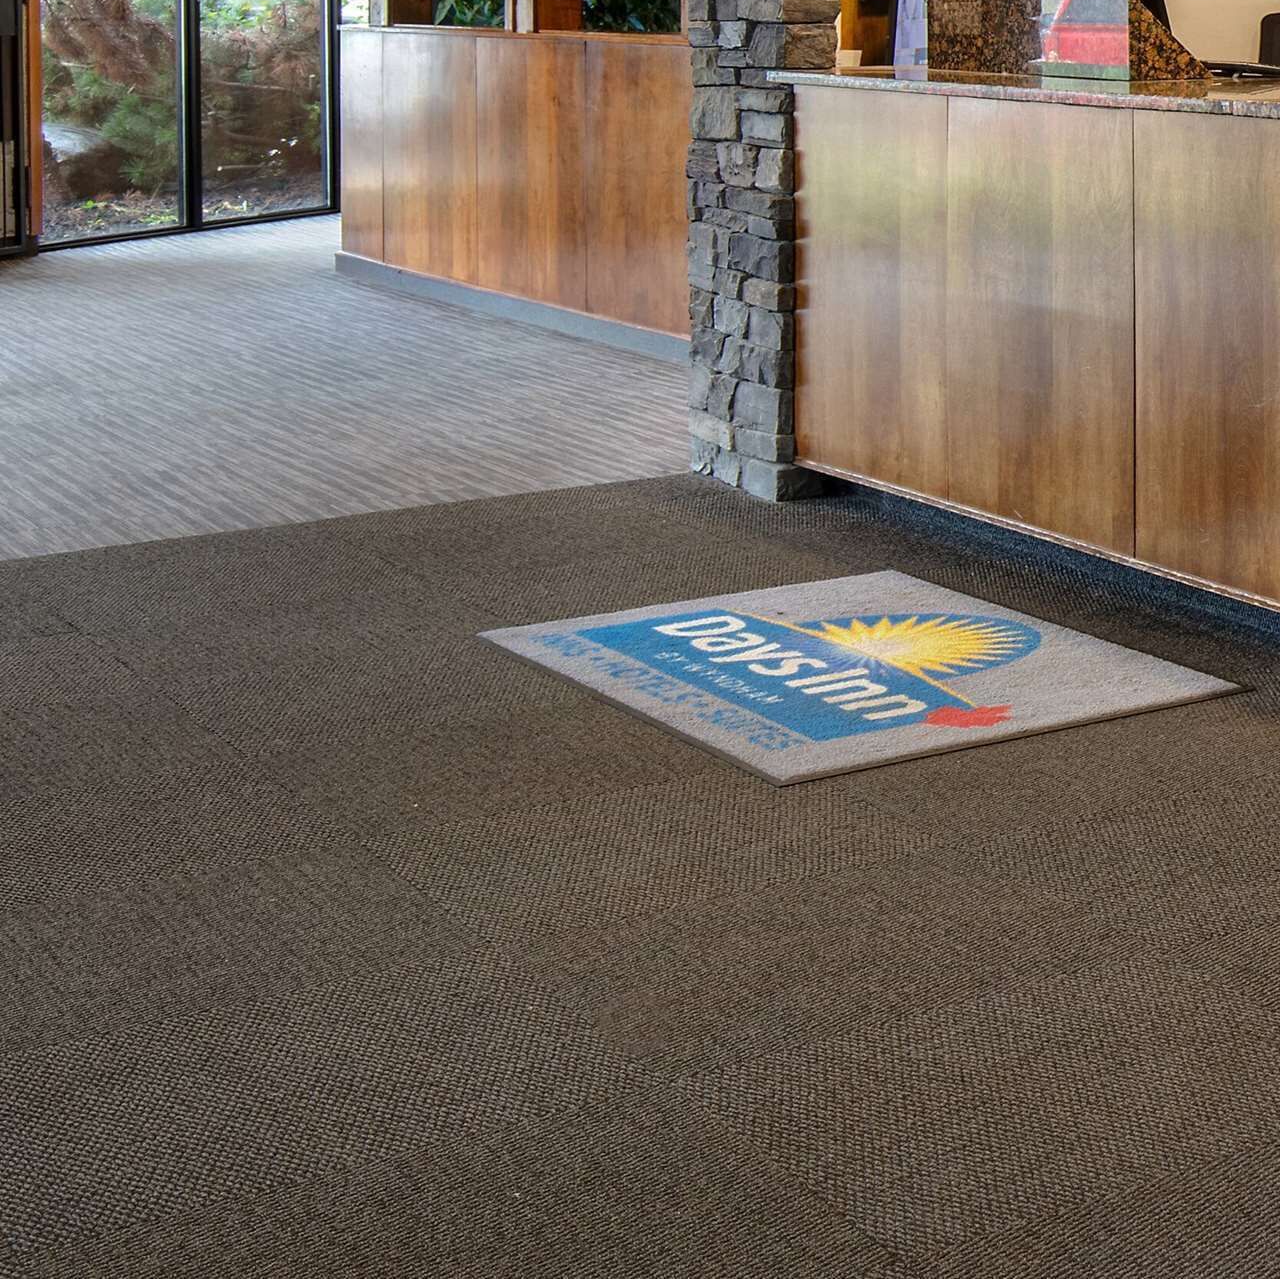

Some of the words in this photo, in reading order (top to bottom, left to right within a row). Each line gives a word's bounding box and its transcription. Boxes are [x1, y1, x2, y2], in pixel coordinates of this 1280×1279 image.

[653, 615, 828, 677] Days
[785, 668, 928, 720] Inn
[654, 651, 691, 663] BY
[684, 663, 785, 705] WYNDHAM
